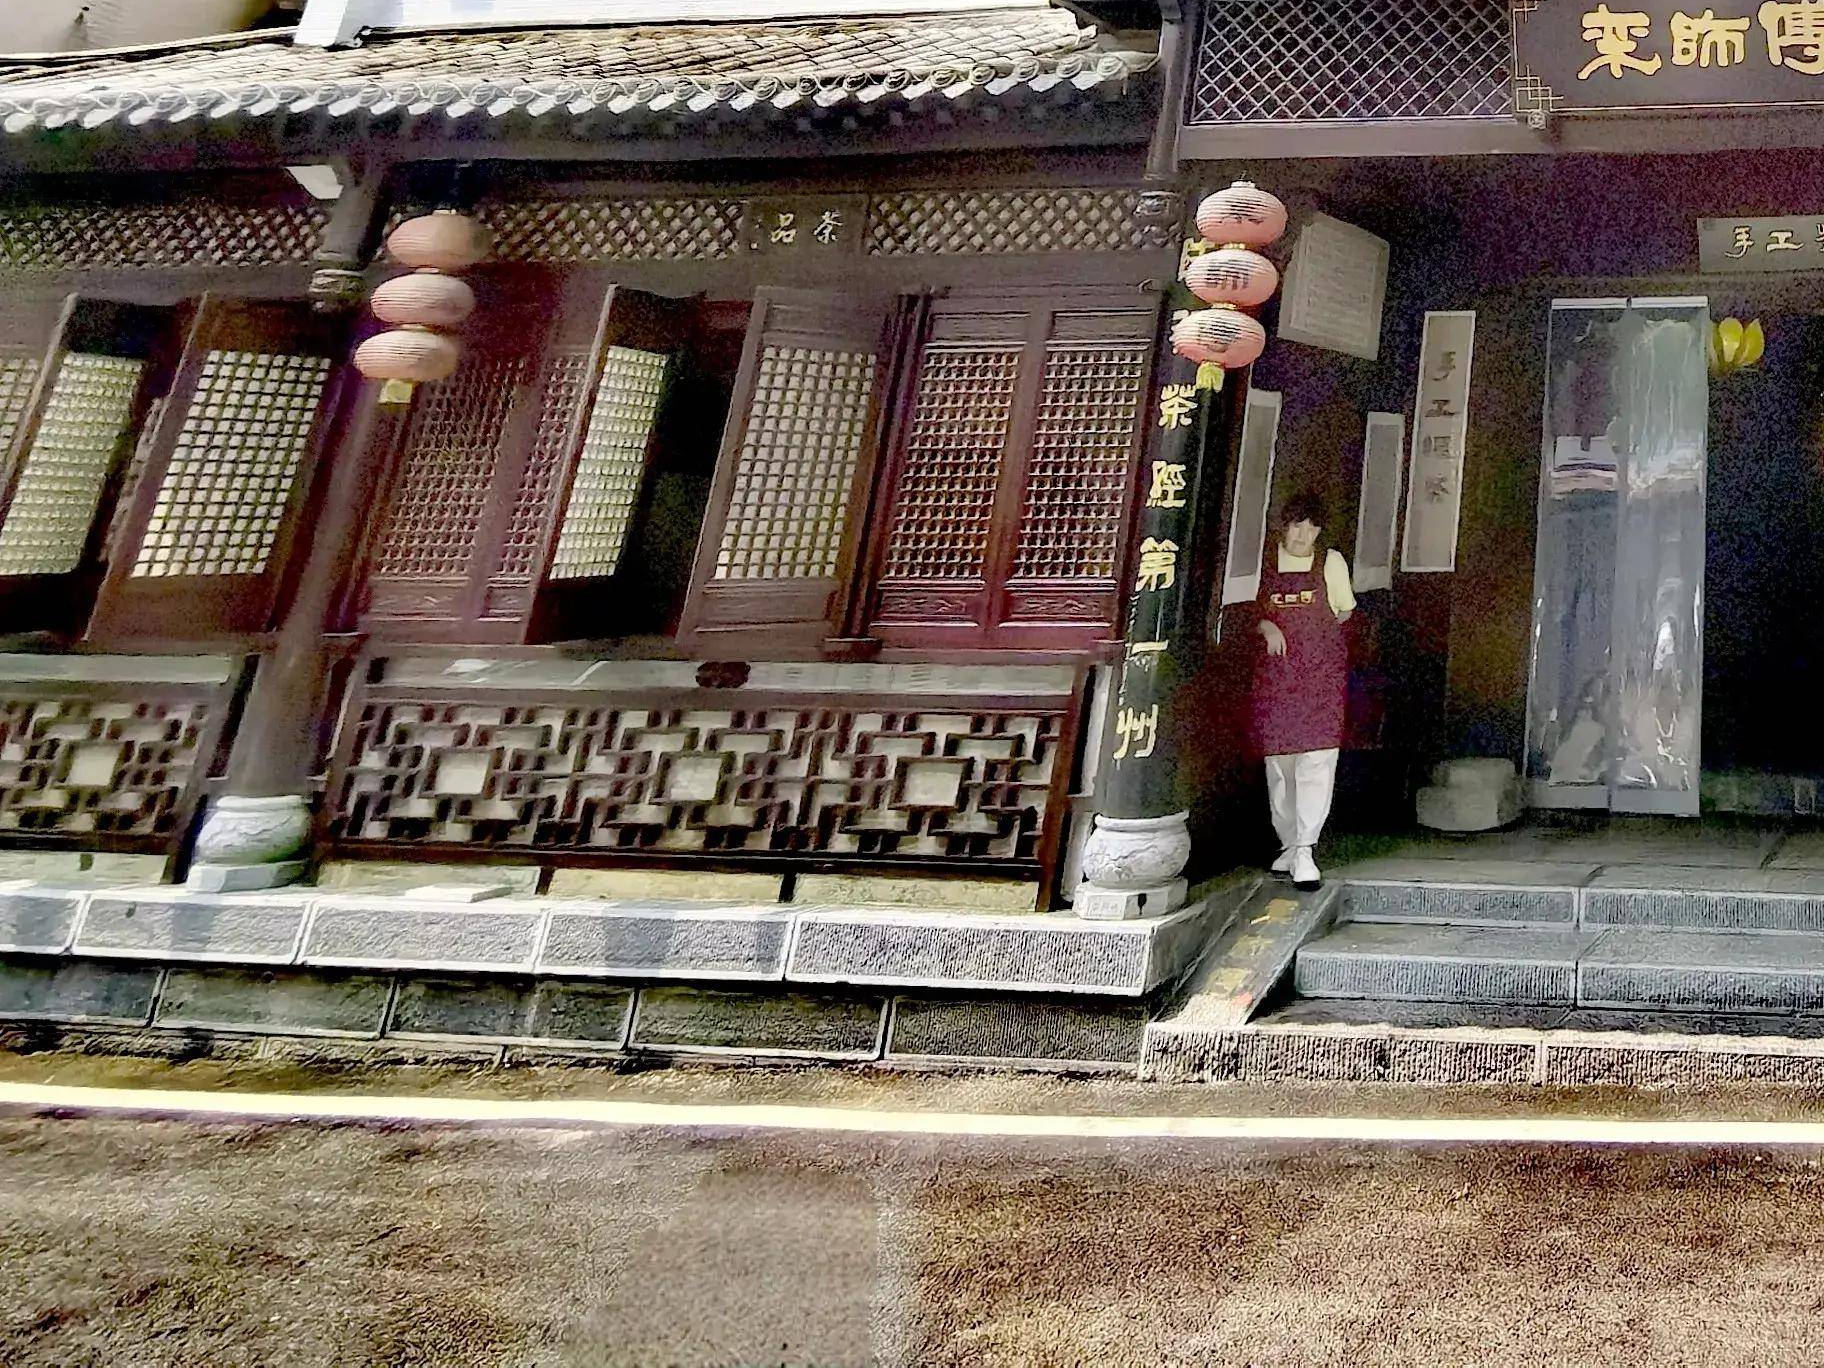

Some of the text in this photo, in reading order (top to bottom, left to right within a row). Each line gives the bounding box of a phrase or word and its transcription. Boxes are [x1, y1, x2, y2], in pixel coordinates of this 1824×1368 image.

[1113, 236, 1214, 770] 茶經第一州
